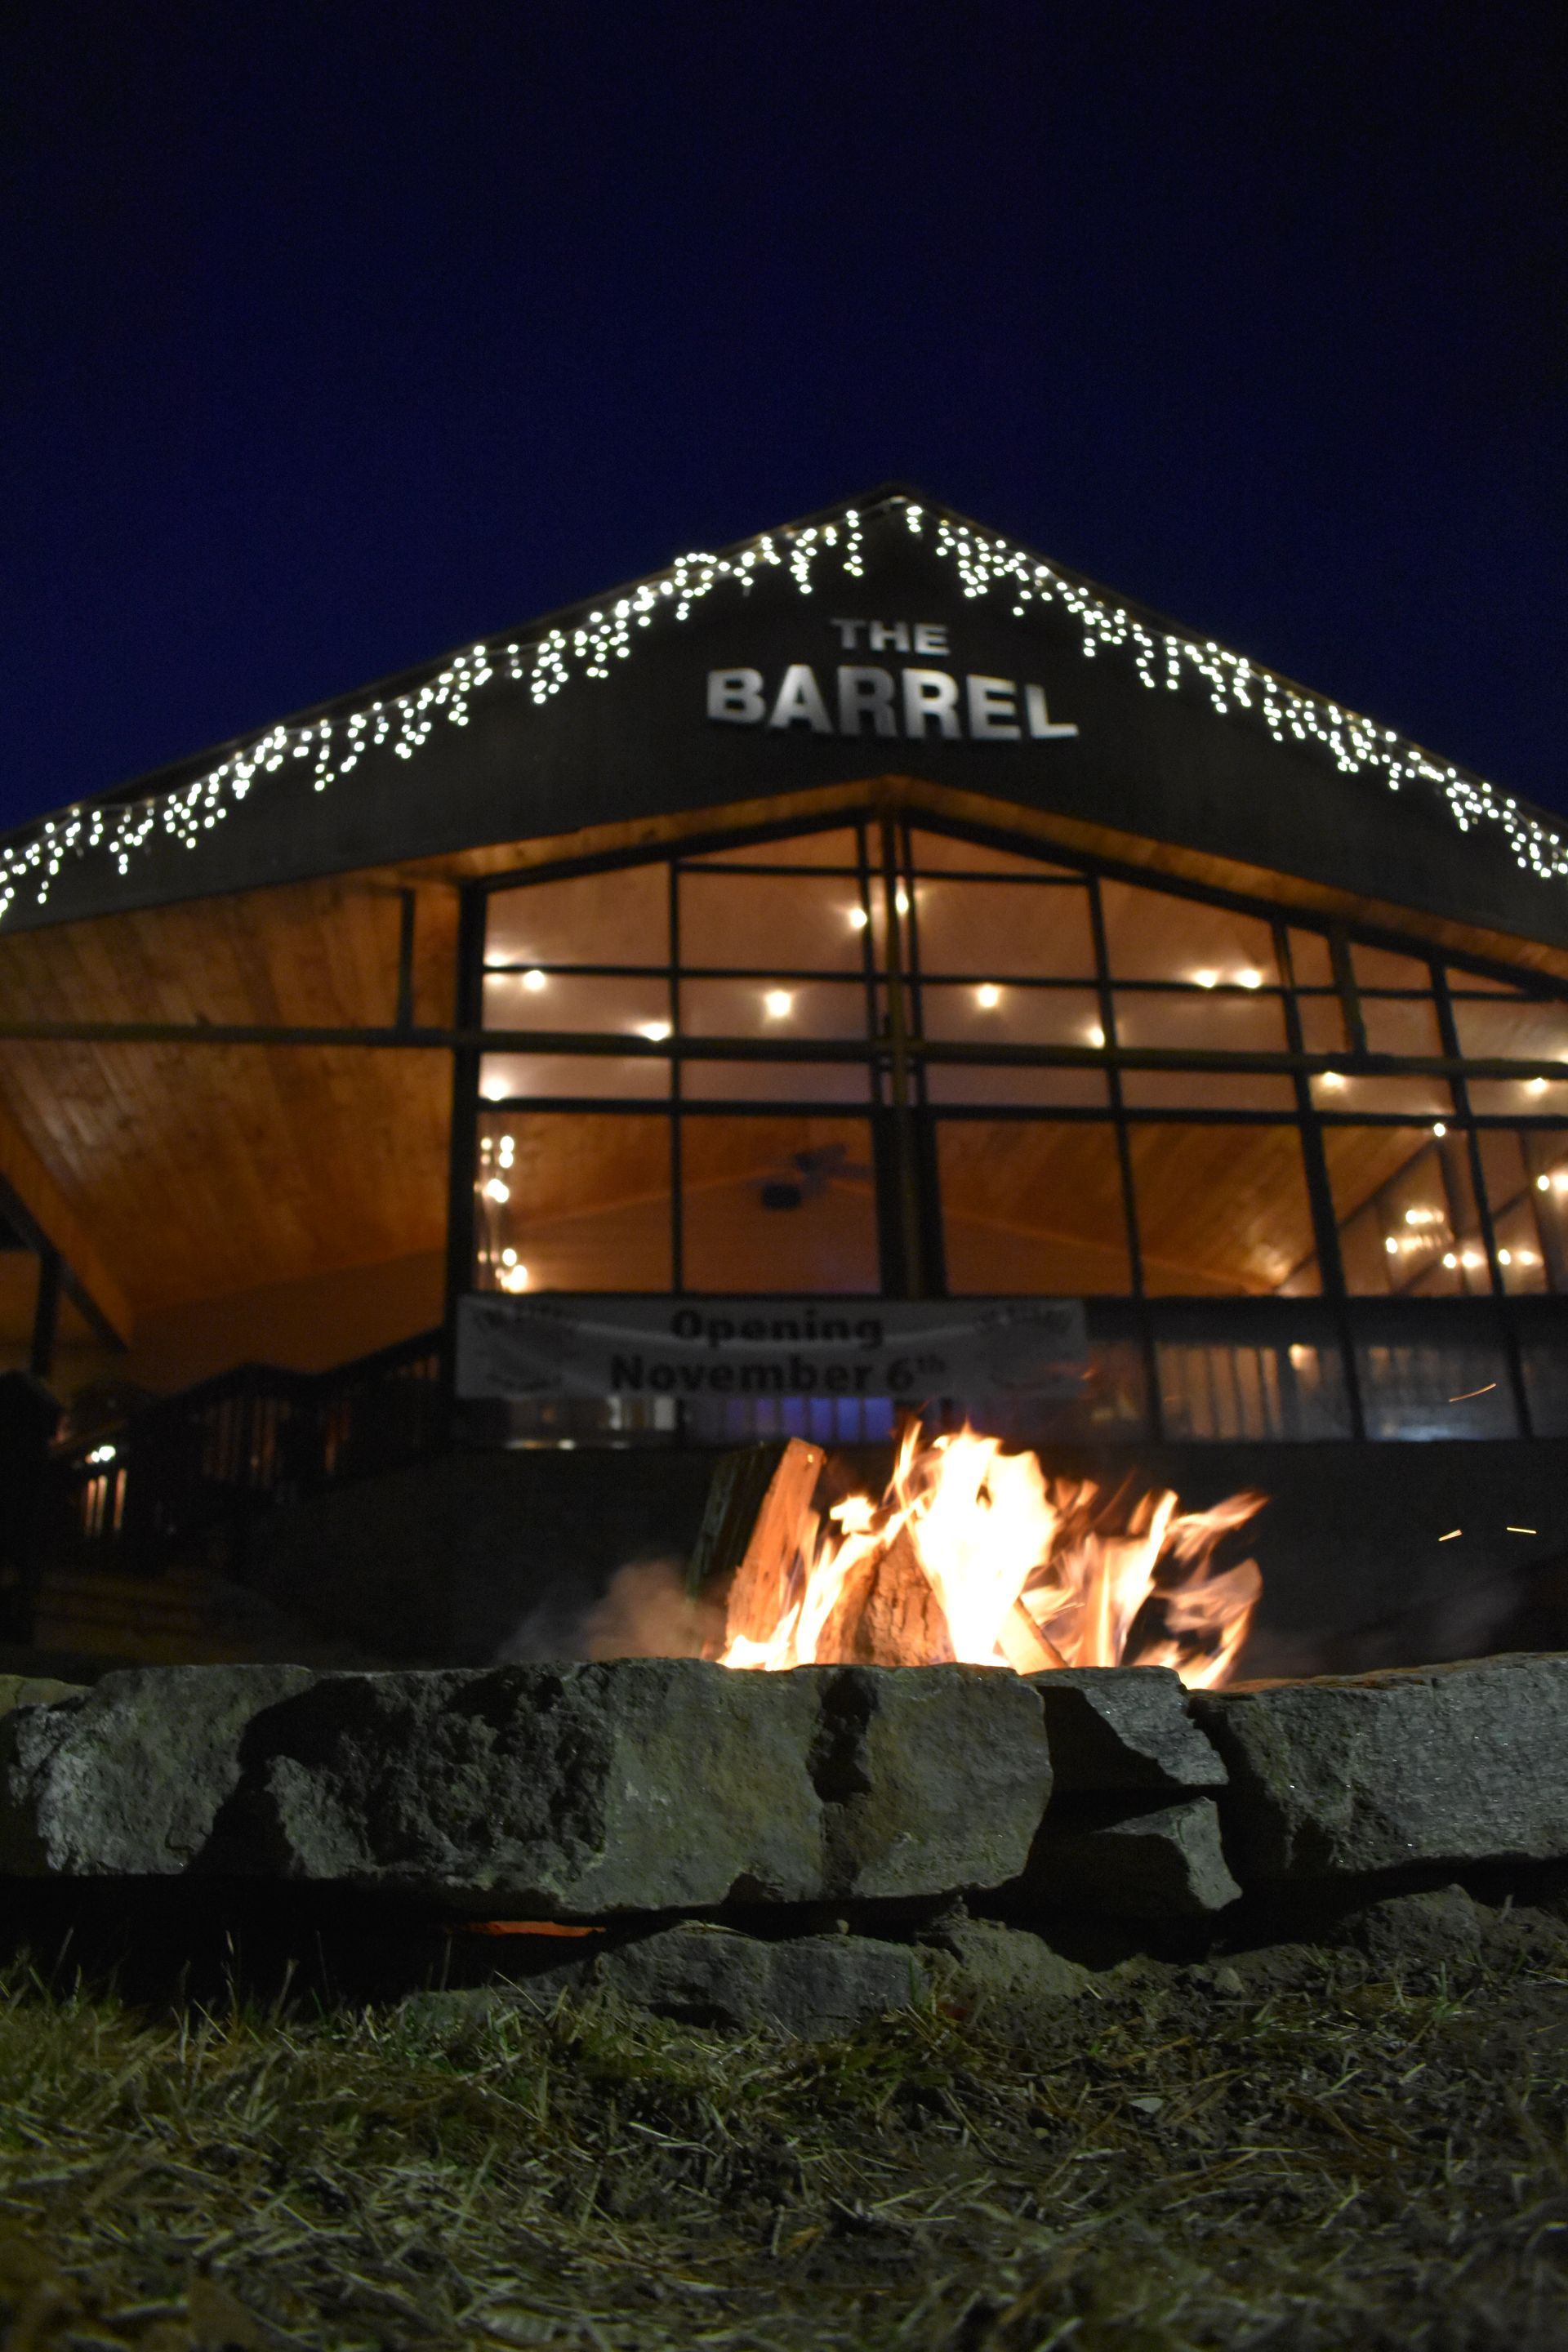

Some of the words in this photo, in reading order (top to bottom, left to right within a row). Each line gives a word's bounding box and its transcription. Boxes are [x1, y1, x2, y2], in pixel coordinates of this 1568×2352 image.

[831, 617, 951, 655] THE
[706, 663, 1080, 741] BARREL
[670, 1310, 884, 1351] Opening
[610, 1356, 874, 1390] November
[886, 1353, 947, 1390] 6th
